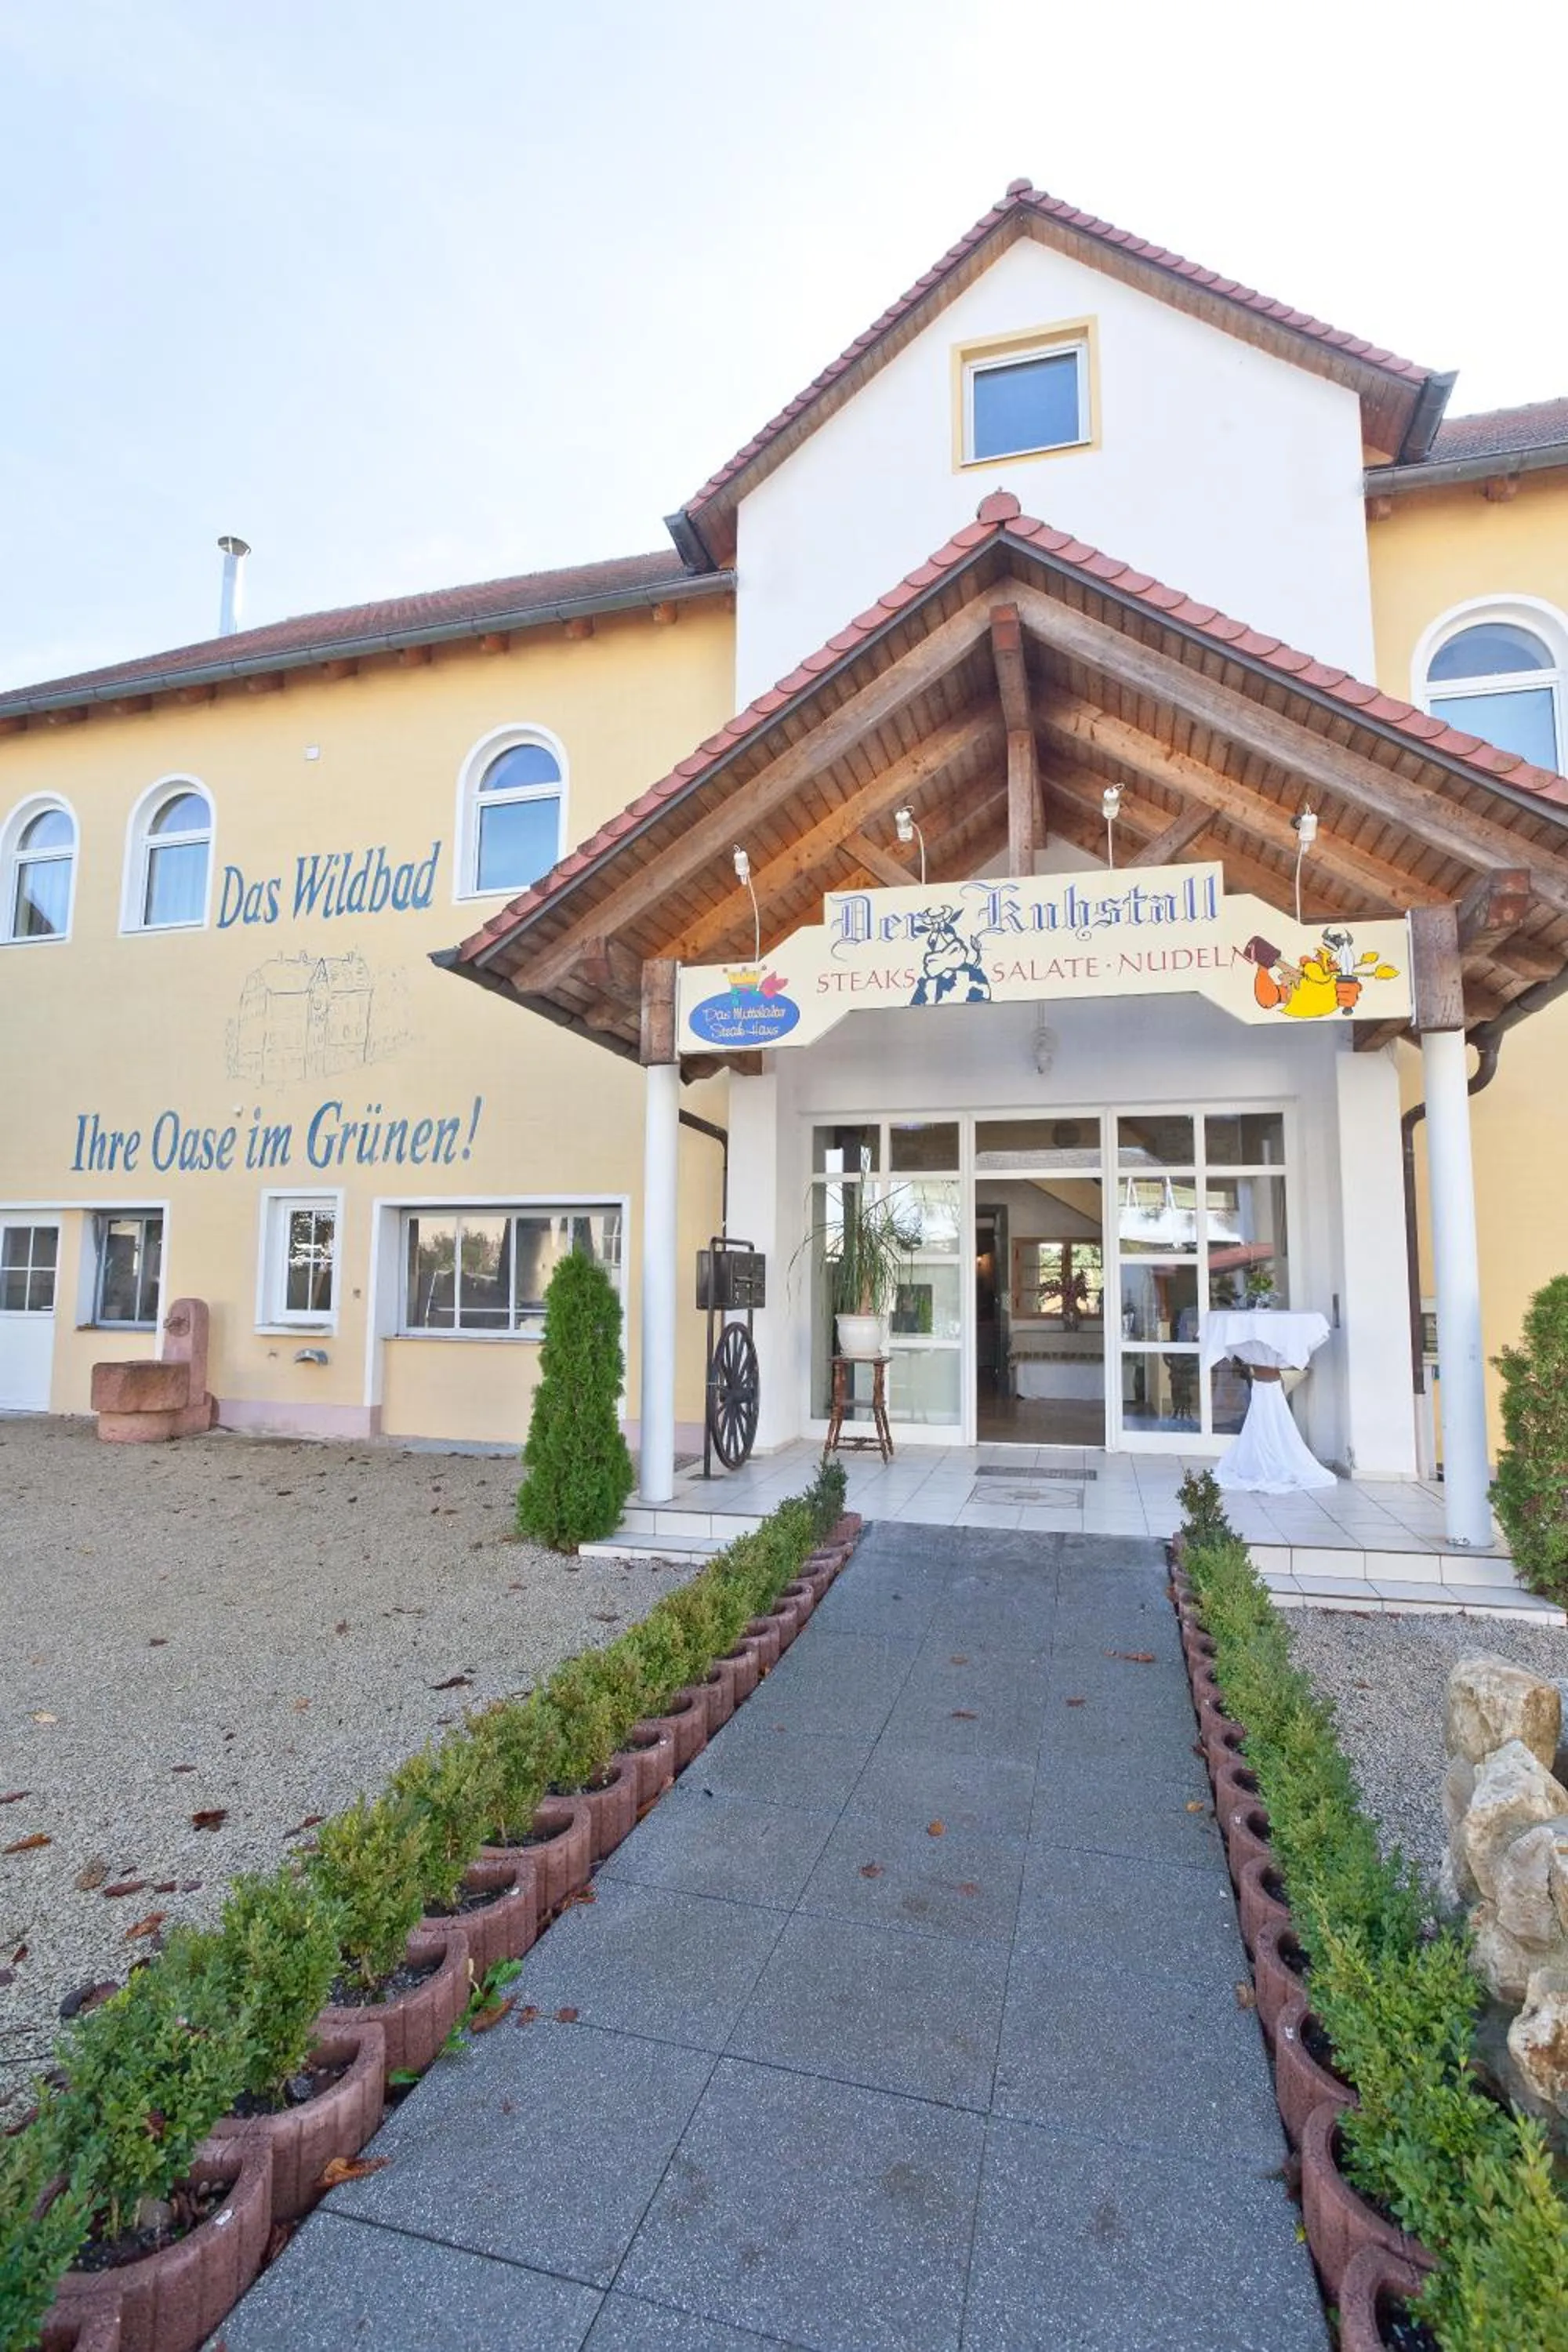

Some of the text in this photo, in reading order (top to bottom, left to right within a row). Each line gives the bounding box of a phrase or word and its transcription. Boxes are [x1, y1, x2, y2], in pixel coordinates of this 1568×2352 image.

[217, 841, 441, 929] Das Wildbad
[829, 875, 1218, 961] Der Kuhstall
[816, 944, 1255, 993] STEAKS SALATE NUDELN
[71, 1095, 482, 1172] Ihre Oase im Grünen!
